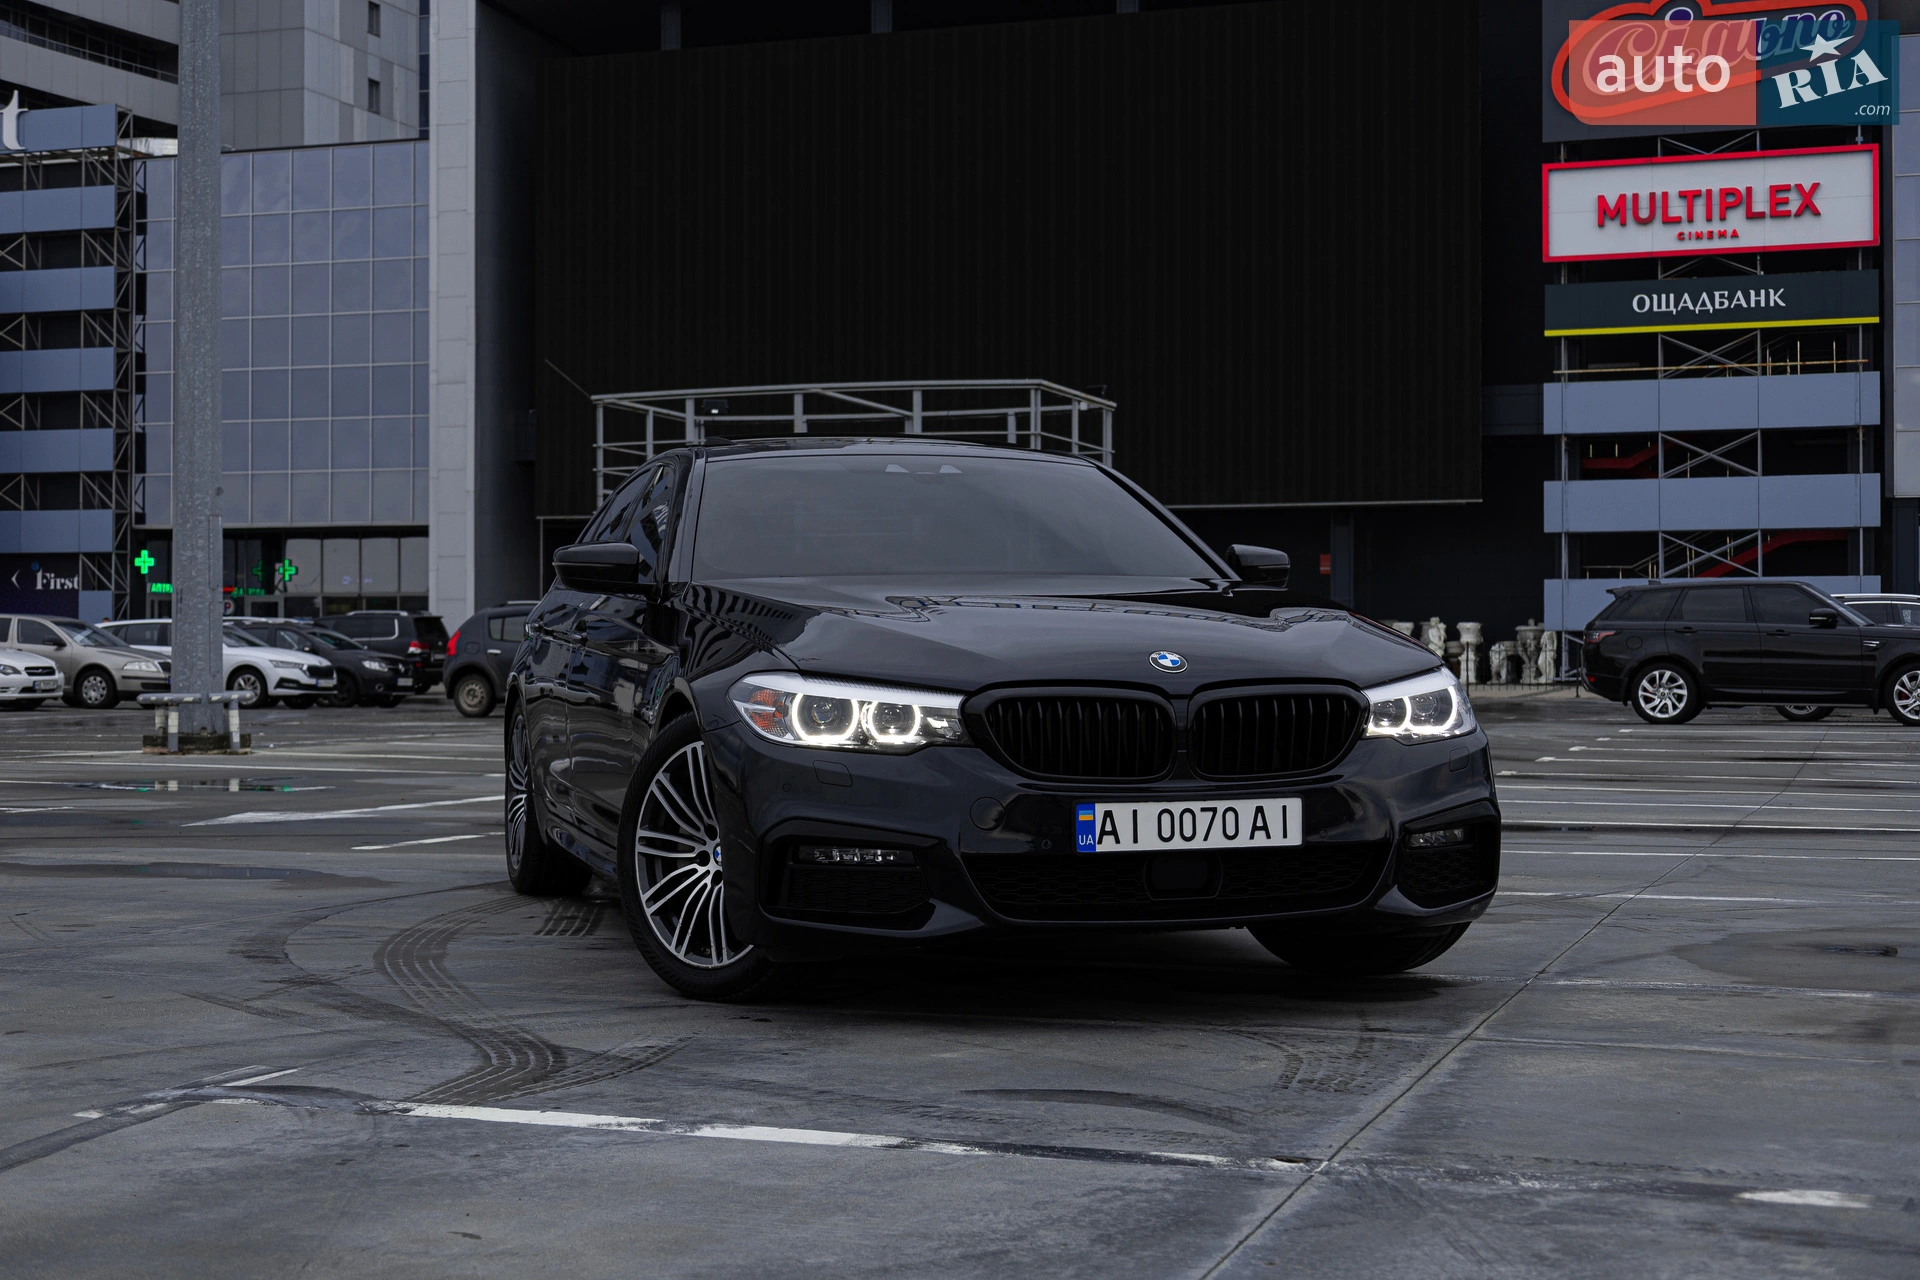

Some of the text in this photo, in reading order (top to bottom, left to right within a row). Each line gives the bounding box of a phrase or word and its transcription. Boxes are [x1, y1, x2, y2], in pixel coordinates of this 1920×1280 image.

[1597, 182, 1821, 228] MULTIPLEX
[1677, 229, 1740, 241] CINEMA
[1632, 288, 1786, 314] ОЩАДБАНК
[1157, 806, 1240, 842] 0070
[1079, 835, 1094, 845] UA
